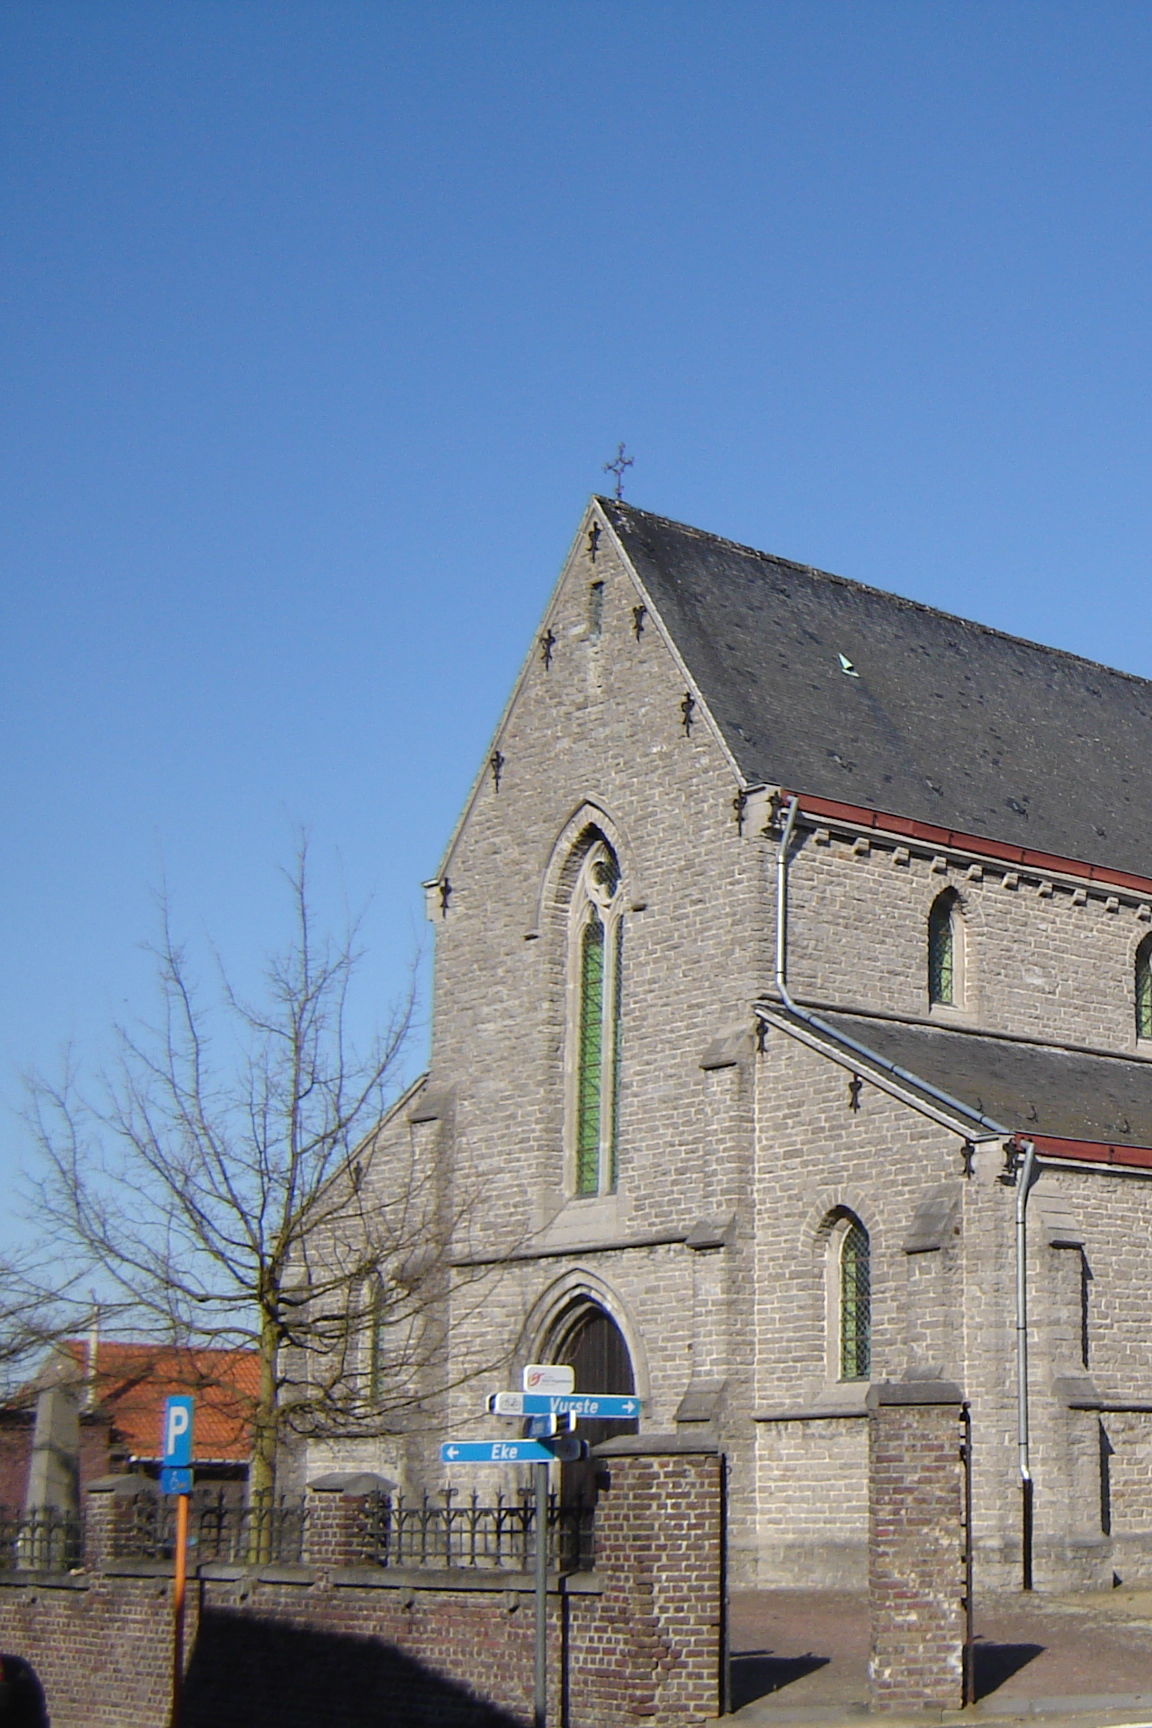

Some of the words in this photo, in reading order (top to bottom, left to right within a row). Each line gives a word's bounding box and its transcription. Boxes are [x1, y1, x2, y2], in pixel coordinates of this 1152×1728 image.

[550, 1397, 599, 1414] Vurste
[167, 1406, 189, 1455] P
[491, 1443, 518, 1460] Eke
